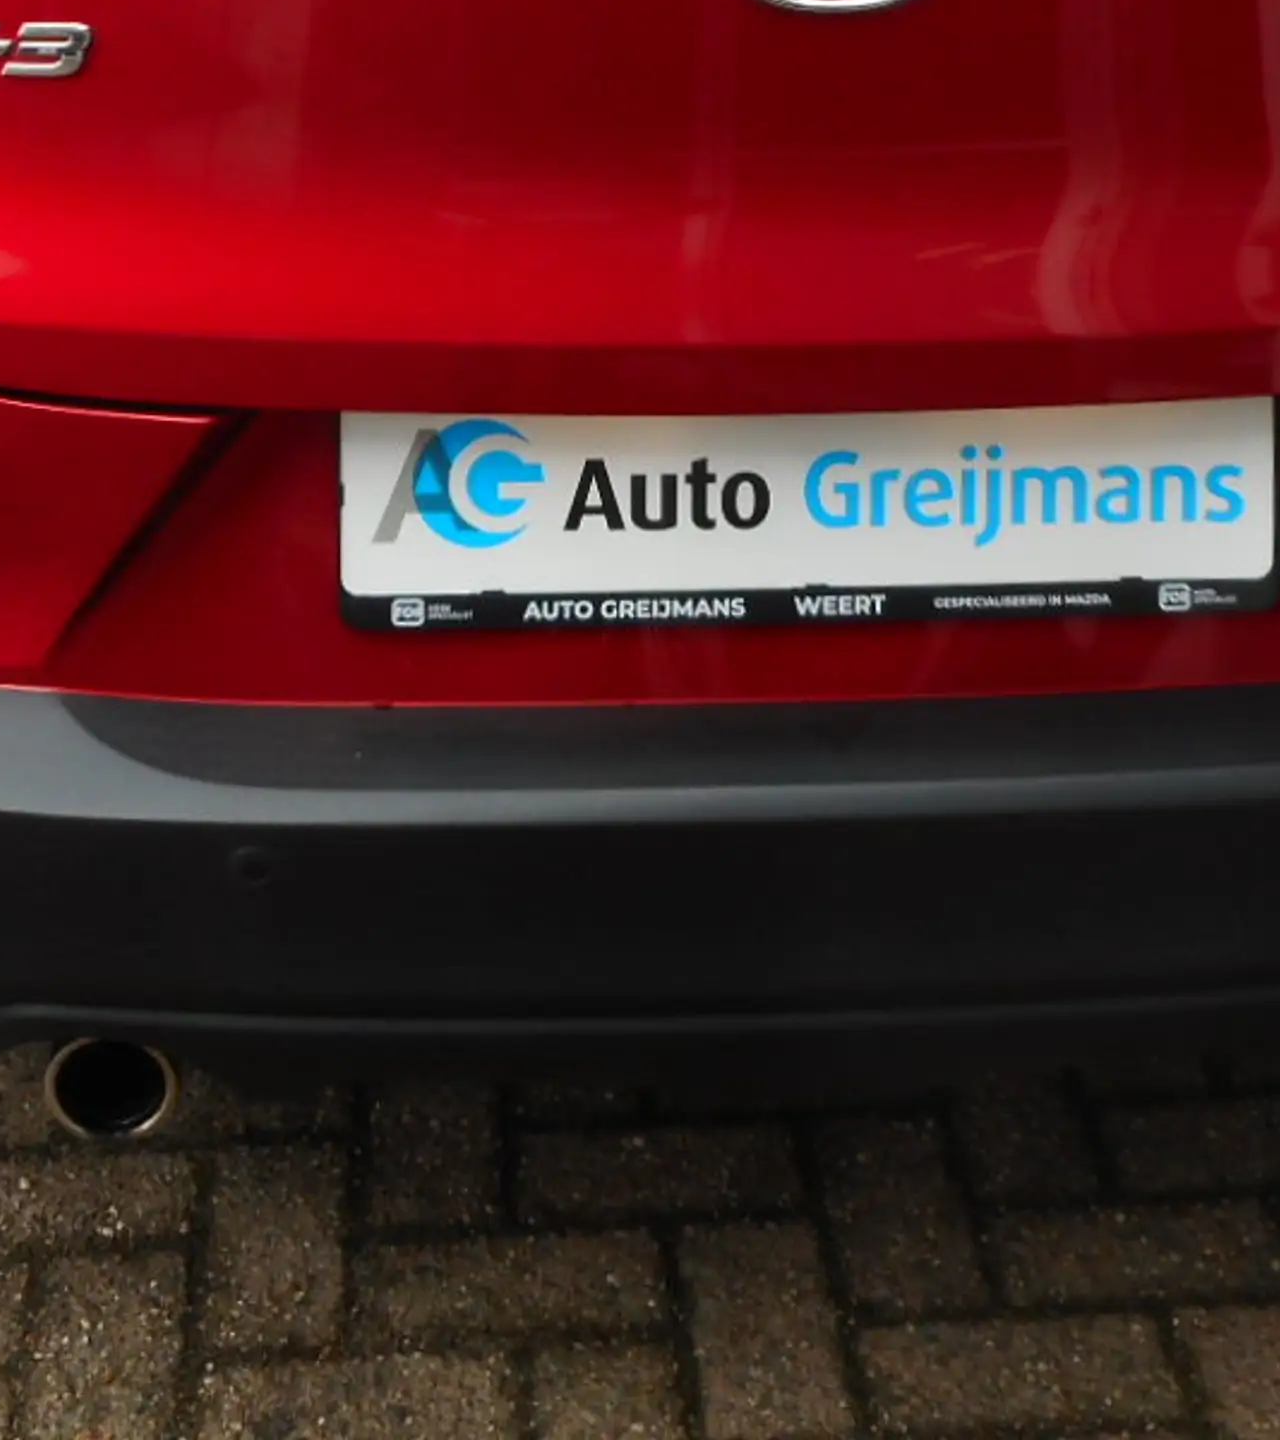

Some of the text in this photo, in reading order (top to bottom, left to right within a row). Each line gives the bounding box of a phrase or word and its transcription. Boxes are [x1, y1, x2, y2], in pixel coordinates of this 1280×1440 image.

[563, 457, 772, 532] Auto
[803, 444, 1246, 548] Greijmans
[522, 597, 747, 622] AUTO GREIJMANS
[793, 593, 887, 617] WEERT
